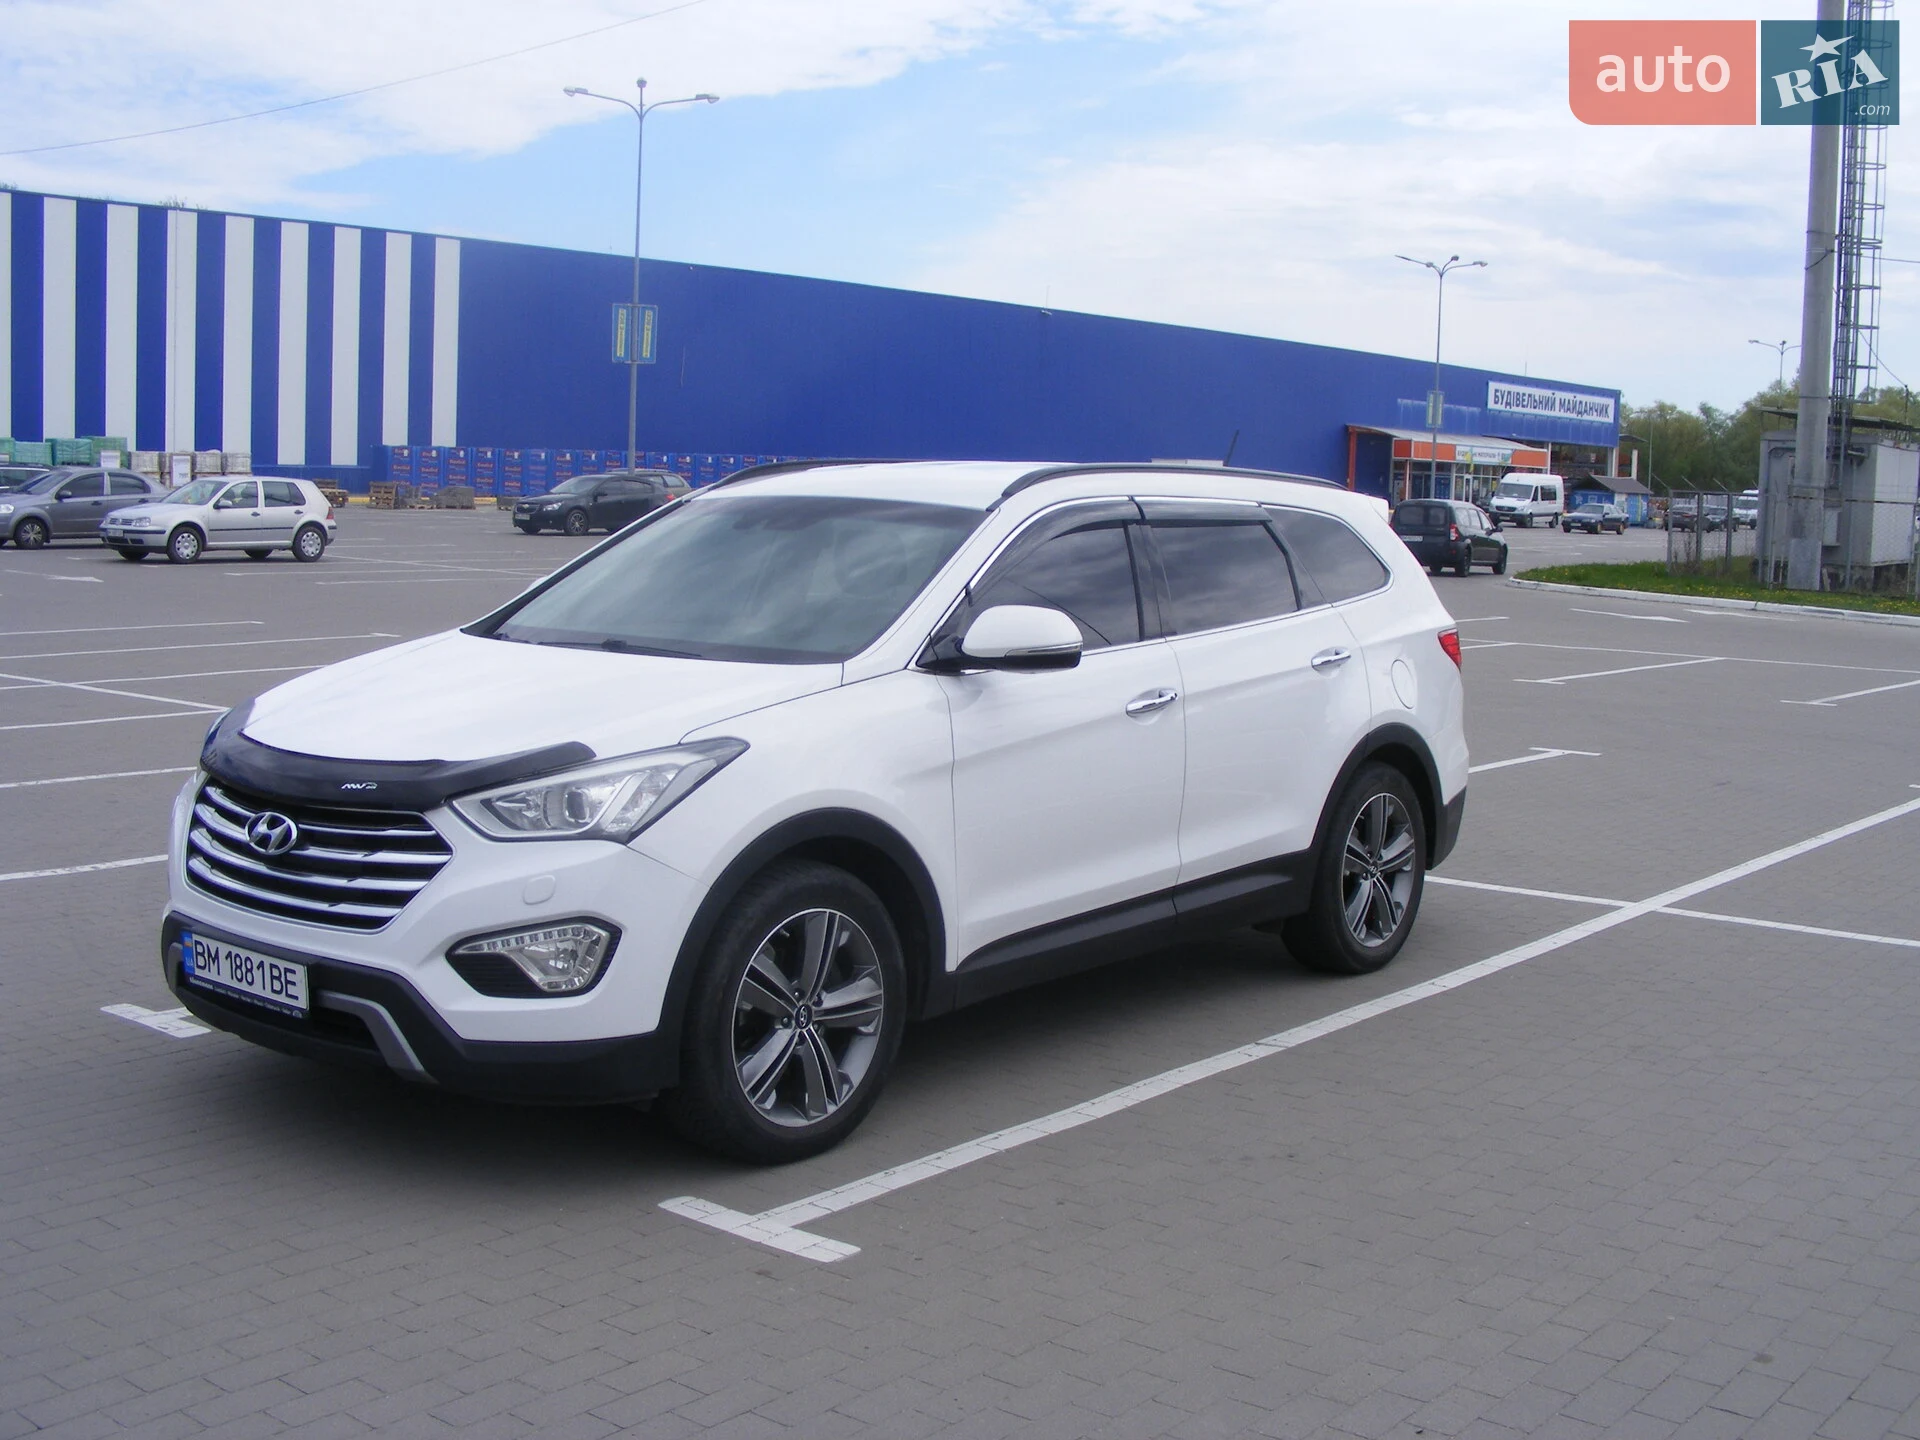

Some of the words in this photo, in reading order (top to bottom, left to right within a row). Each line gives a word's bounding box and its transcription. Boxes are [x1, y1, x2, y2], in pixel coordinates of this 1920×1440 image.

[1493, 388, 1556, 412] БУДІВЕЛЬНИЙ
[1558, 395, 1610, 419] МАЙДАНЧИК
[194, 939, 220, 976] BM
[225, 950, 266, 991] 1881
[269, 962, 299, 1001] BE
